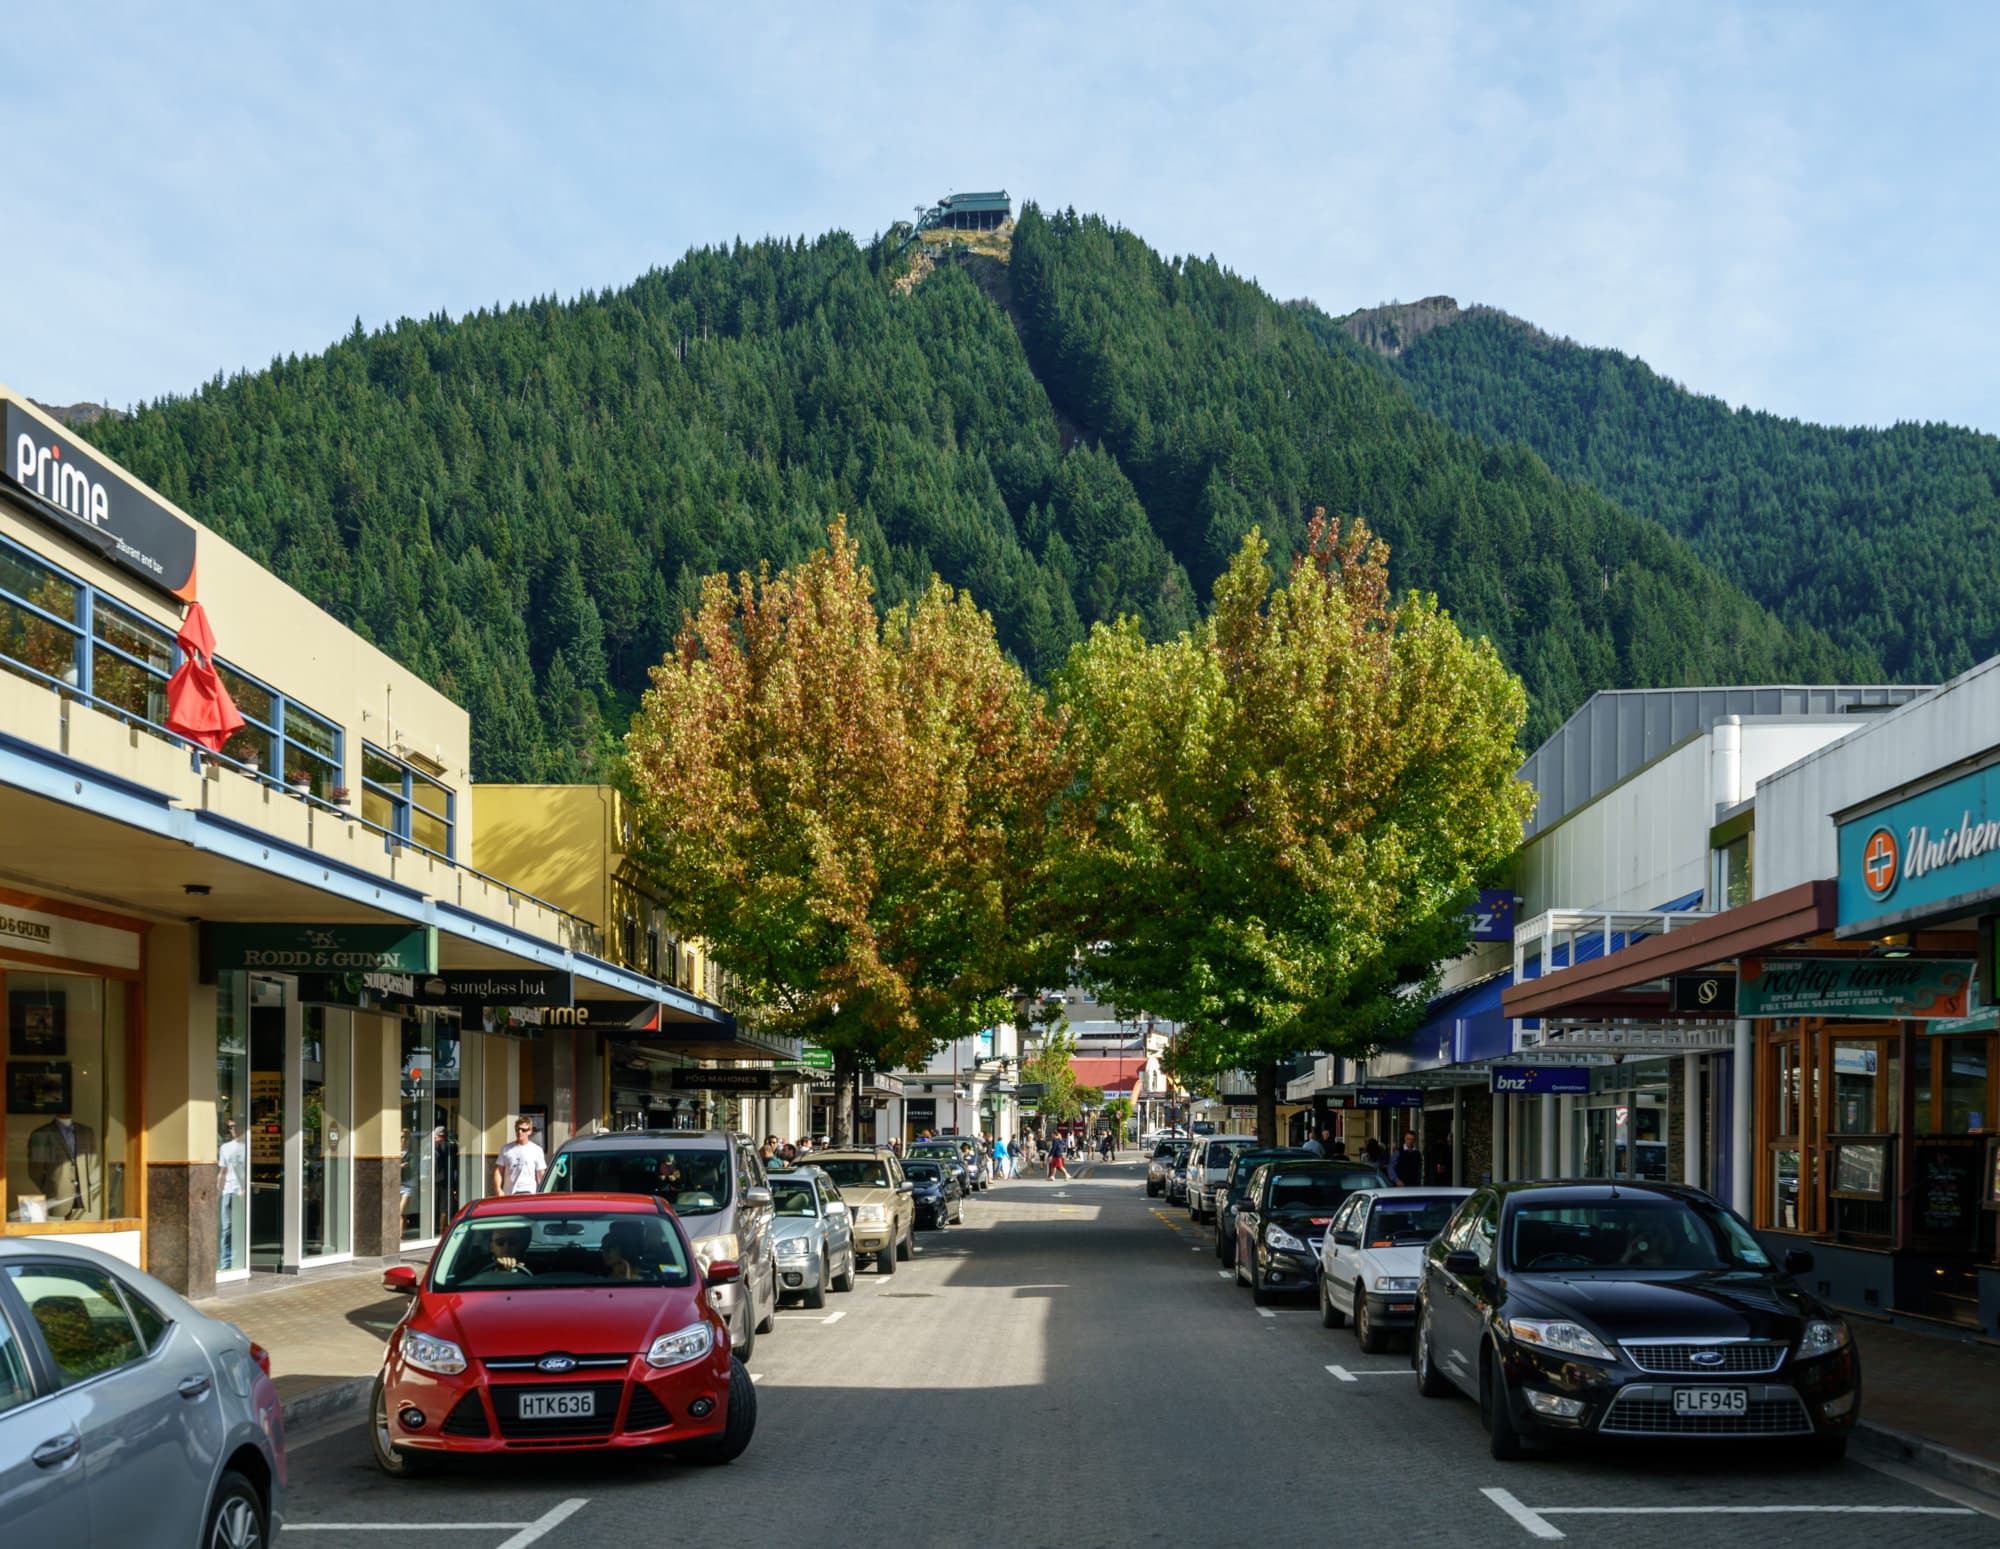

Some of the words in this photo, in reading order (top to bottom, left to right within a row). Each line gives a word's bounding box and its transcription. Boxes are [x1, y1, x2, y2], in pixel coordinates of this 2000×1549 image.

[17, 433, 109, 525] prime
[141, 554, 153, 569] and
[153, 559, 164, 574] bar
[1452, 913, 1493, 932] nz
[243, 951, 312, 967] RODD
[314, 952, 329, 967] &
[331, 953, 400, 968] GUNN
[450, 978, 517, 998] sunglass
[519, 978, 547, 995] hut
[1762, 960, 1841, 1000] rooftop
[1847, 964, 1923, 987] terrace
[1811, 998, 1850, 1008] SERVICE
[1852, 997, 1880, 1006] FROM
[540, 1007, 589, 1025] rime
[1497, 1075, 1526, 1089] bnz
[1359, 1095, 1378, 1105] bnz
[546, 1360, 568, 1368] Ford
[523, 1395, 591, 1415] HTK636
[1676, 1392, 1744, 1409] FLF945
